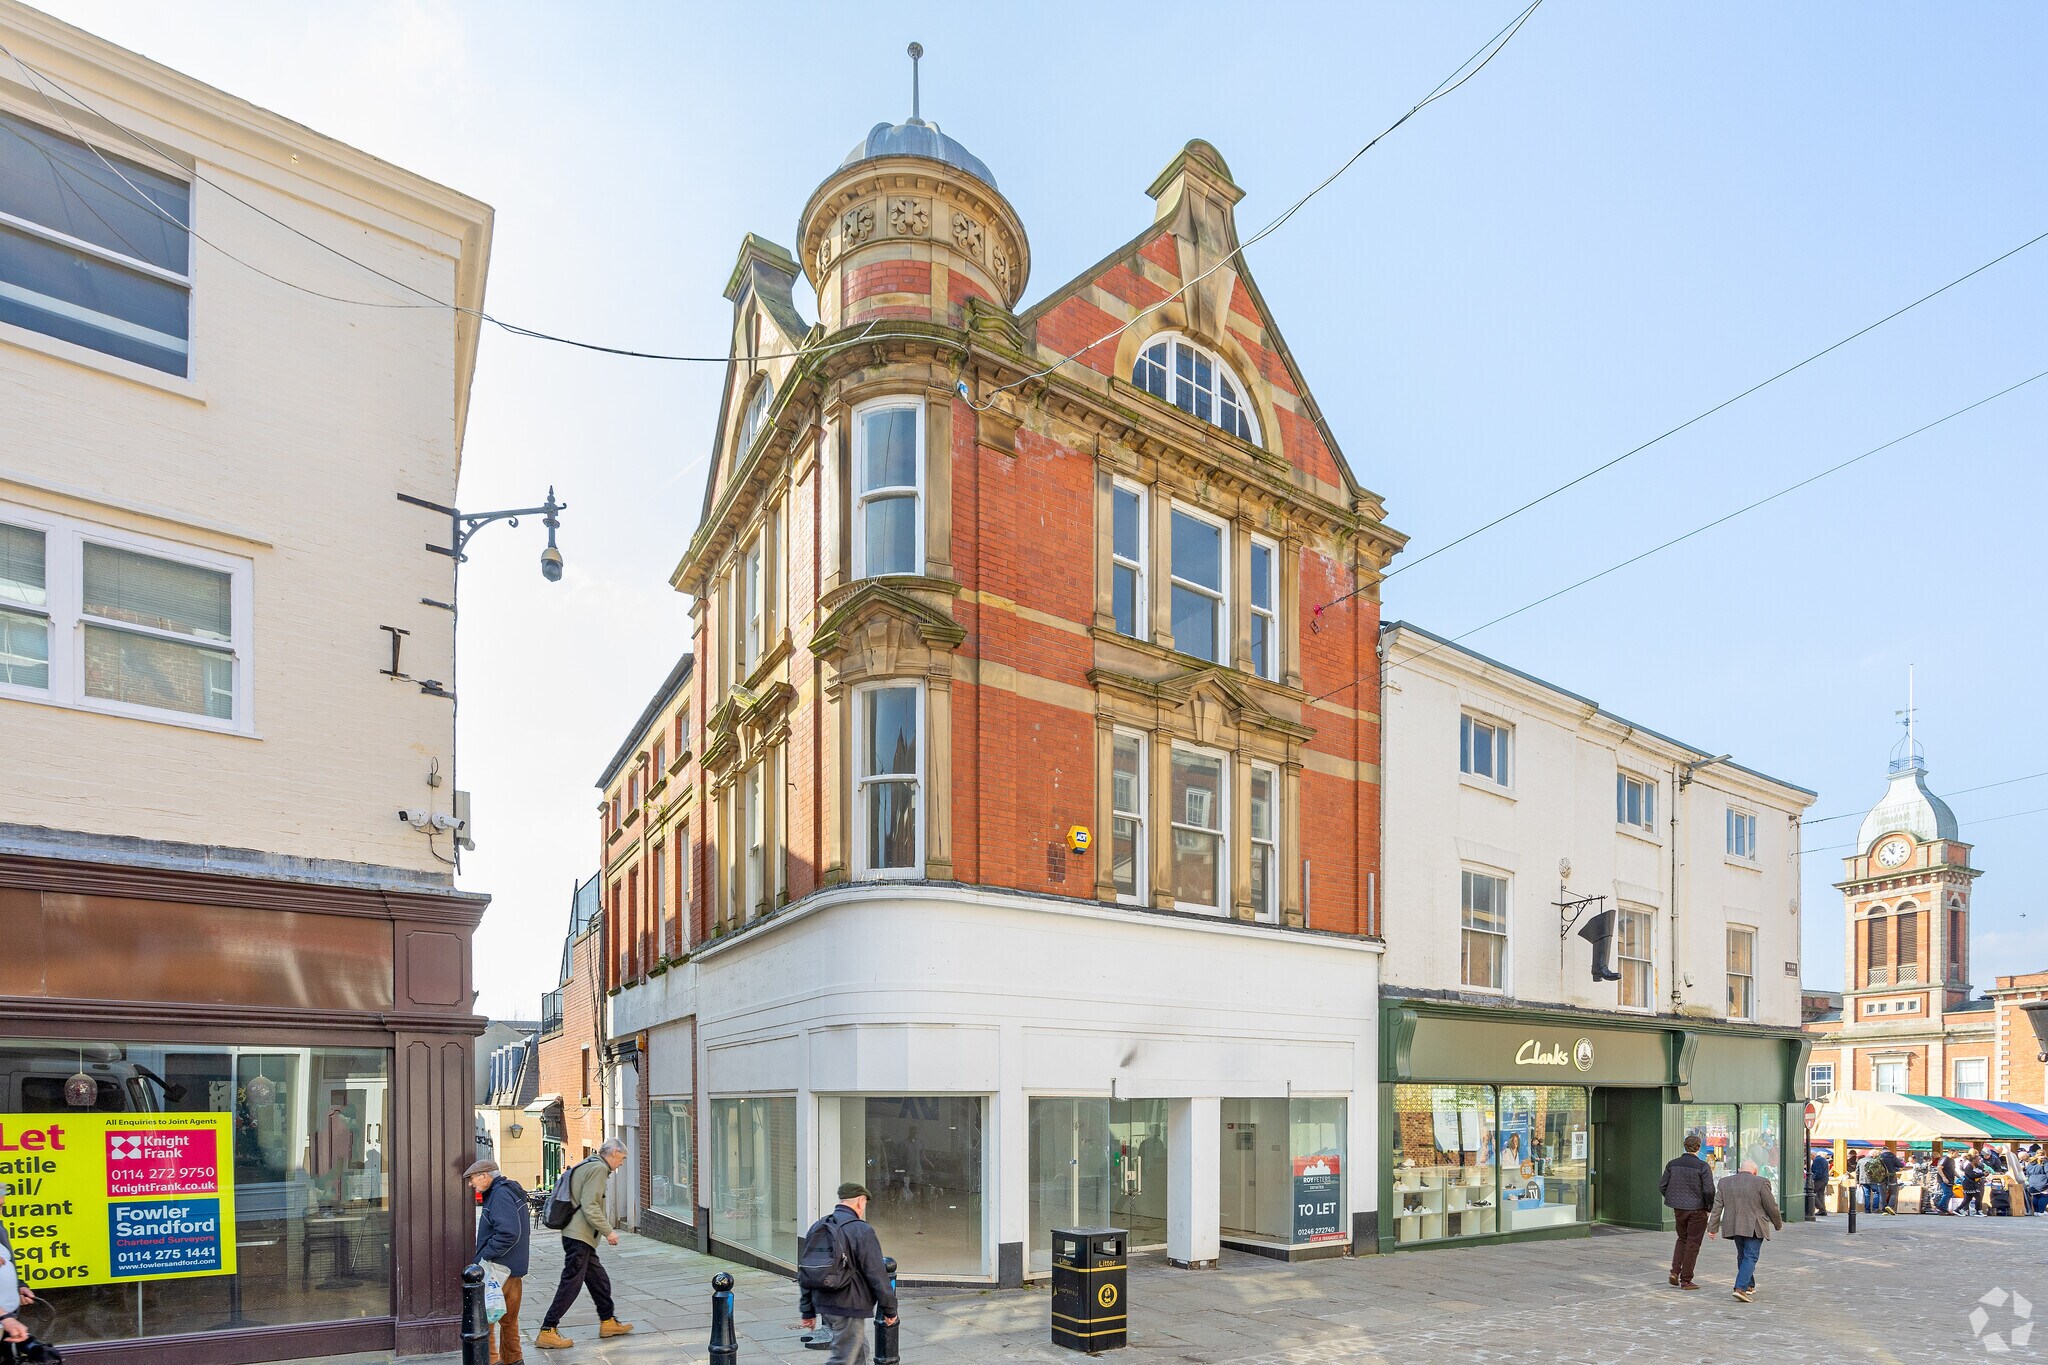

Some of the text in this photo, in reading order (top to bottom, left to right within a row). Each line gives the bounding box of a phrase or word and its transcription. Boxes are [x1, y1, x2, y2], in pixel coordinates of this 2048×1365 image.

[1515, 1039, 1569, 1066] Clarks
[118, 1119, 157, 1127] Enquiries
[189, 1118, 218, 1126] Agents
[0, 1123, 66, 1151] Let
[144, 1136, 190, 1149] Knight
[144, 1148, 183, 1159] Frank
[111, 1166, 215, 1180] 0114 272 9750
[111, 1181, 215, 1194] KnightFrank.co.uk
[116, 1205, 190, 1221] Fowler
[1298, 1202, 1336, 1216] TO LET
[116, 1218, 215, 1237] Sandford
[116, 1235, 215, 1247] Chartered Surveyors
[14, 1240, 71, 1264] sq ft
[118, 1246, 215, 1263] 0114 275 1441
[118, 1259, 216, 1271] www.fowlersandford.com
